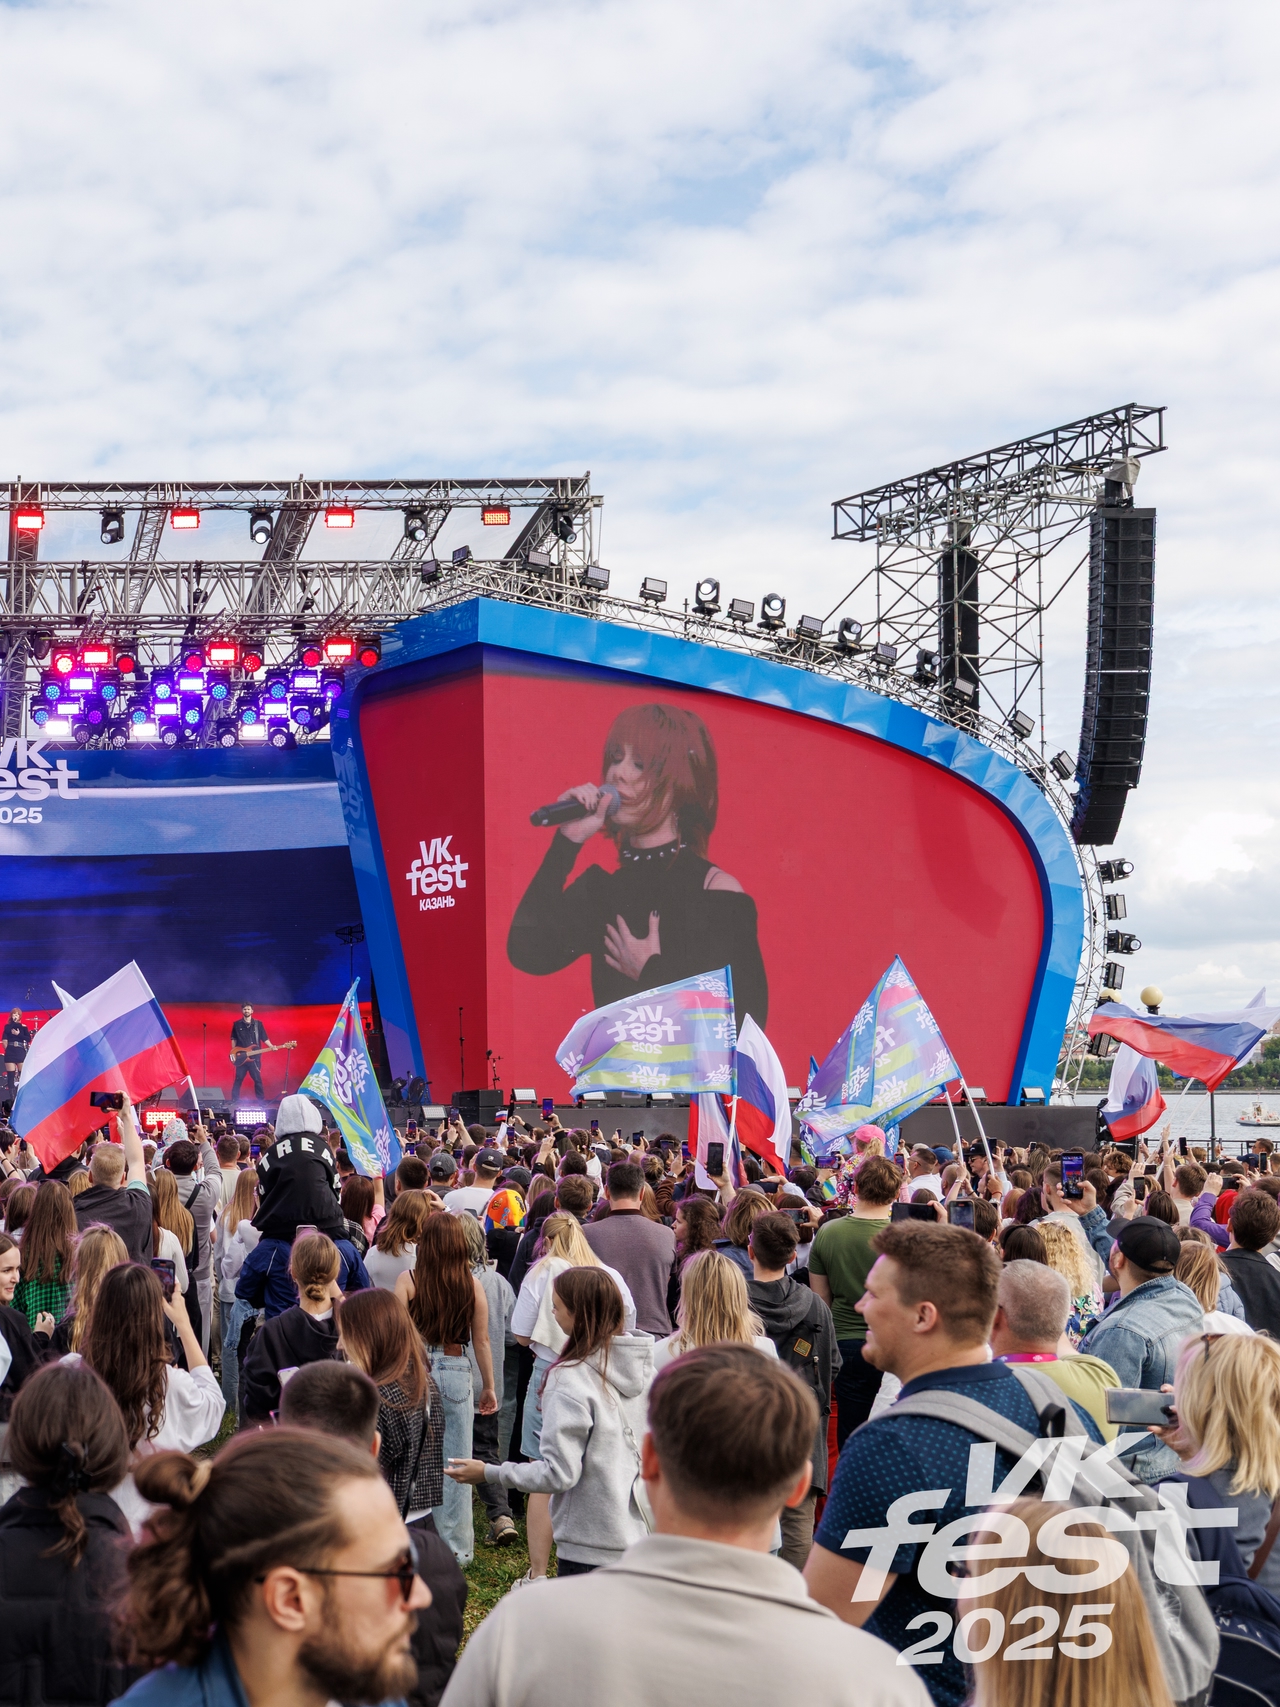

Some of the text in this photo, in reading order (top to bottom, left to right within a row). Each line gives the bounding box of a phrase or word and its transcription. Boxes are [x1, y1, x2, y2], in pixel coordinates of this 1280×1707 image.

[419, 835, 454, 866] VK
[406, 854, 469, 896] fest
[419, 895, 456, 912] КАЗАНЬ
[356, 1052, 370, 1079] VK
